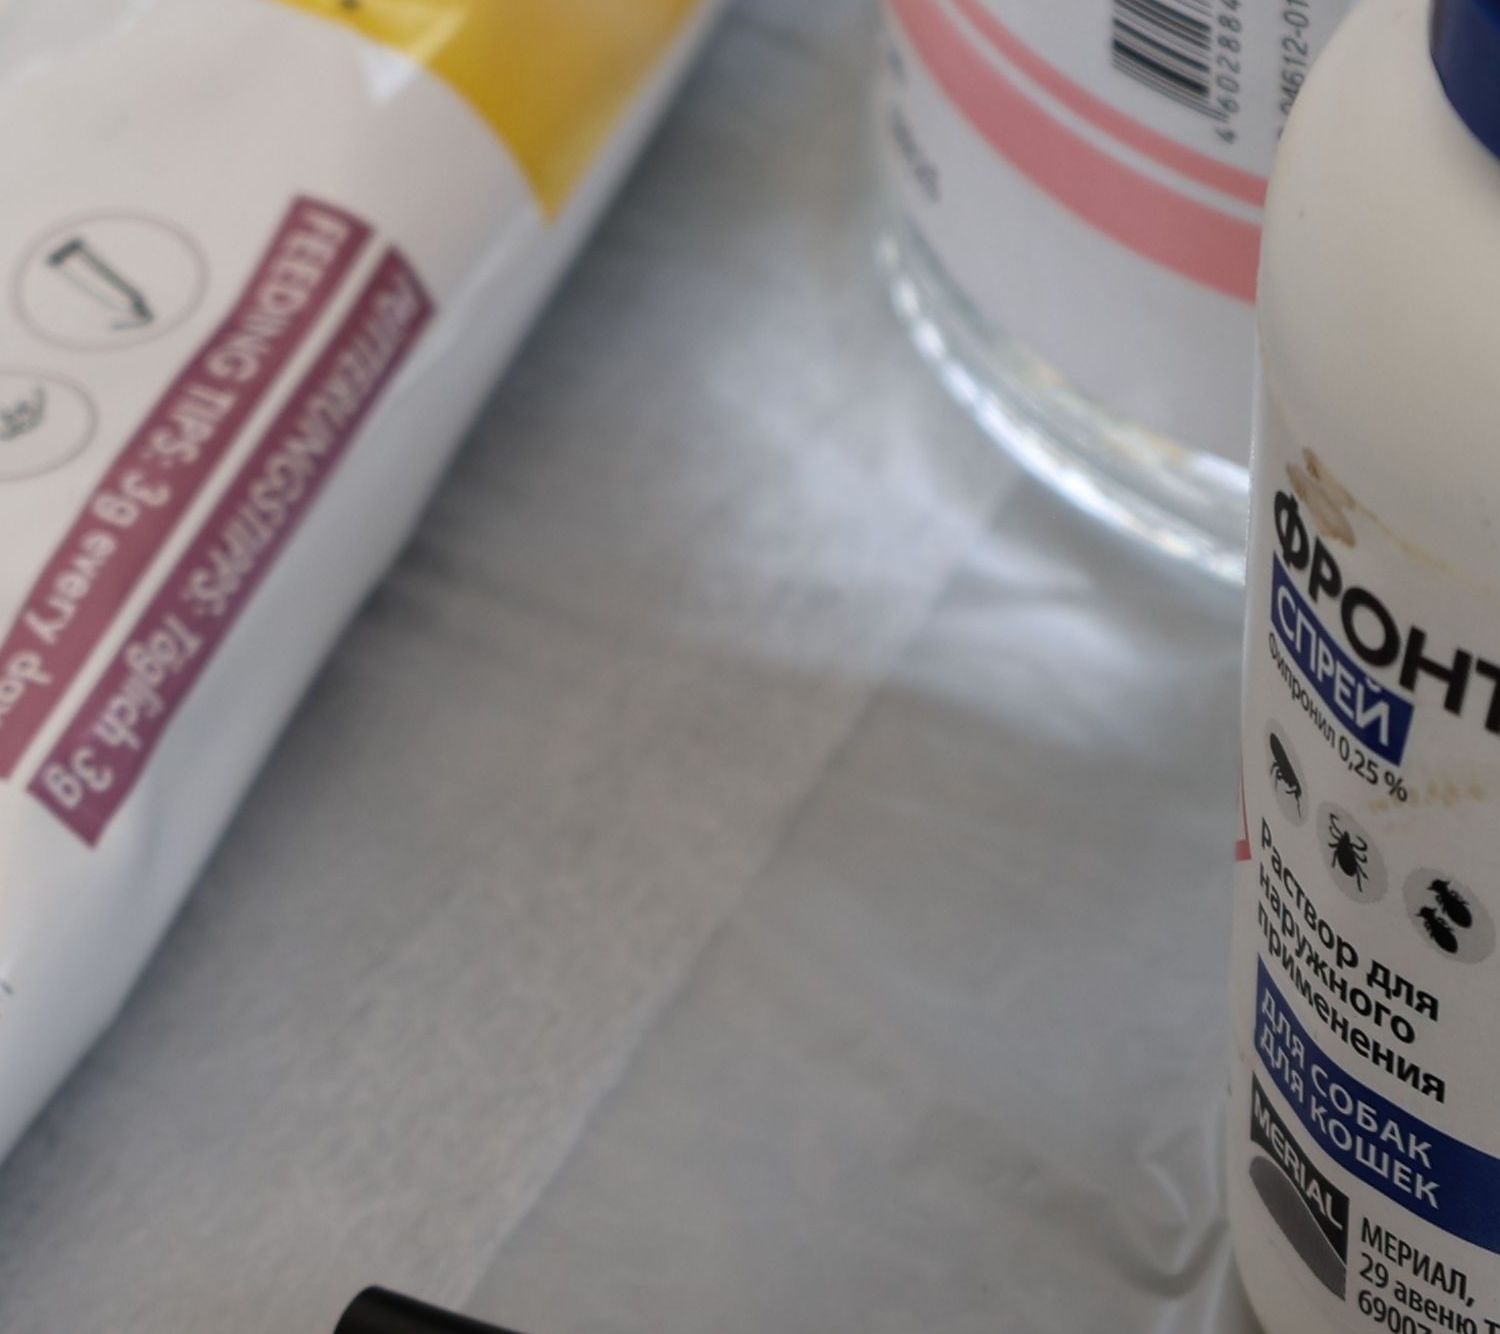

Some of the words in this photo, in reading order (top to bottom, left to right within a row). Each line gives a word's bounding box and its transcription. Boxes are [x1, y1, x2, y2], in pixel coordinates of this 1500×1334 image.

[201, 200, 354, 396] FEEDING
[88, 457, 174, 543] 3g
[138, 369, 240, 488] TIPS:
[16, 520, 124, 650] every
[1277, 584, 1392, 747] СПРЕЙ
[1338, 735, 1379, 786] 0,25
[1384, 771, 1408, 803] %
[1259, 862, 1416, 1045] наружного
[1261, 817, 1359, 969] Раствор
[1366, 959, 1439, 1022] для
[1257, 899, 1445, 1104] применения
[1259, 1022, 1305, 1103] ДЛЯ
[1310, 1094, 1440, 1210] КОШЕК
[1260, 987, 1306, 1063] ДЛЯ
[1312, 1064, 1433, 1169] СОБАК
[1253, 1094, 1344, 1231] MERIAL
[1358, 1252, 1388, 1289] 29
[1360, 1216, 1476, 1309] МЕРИАЛ,
